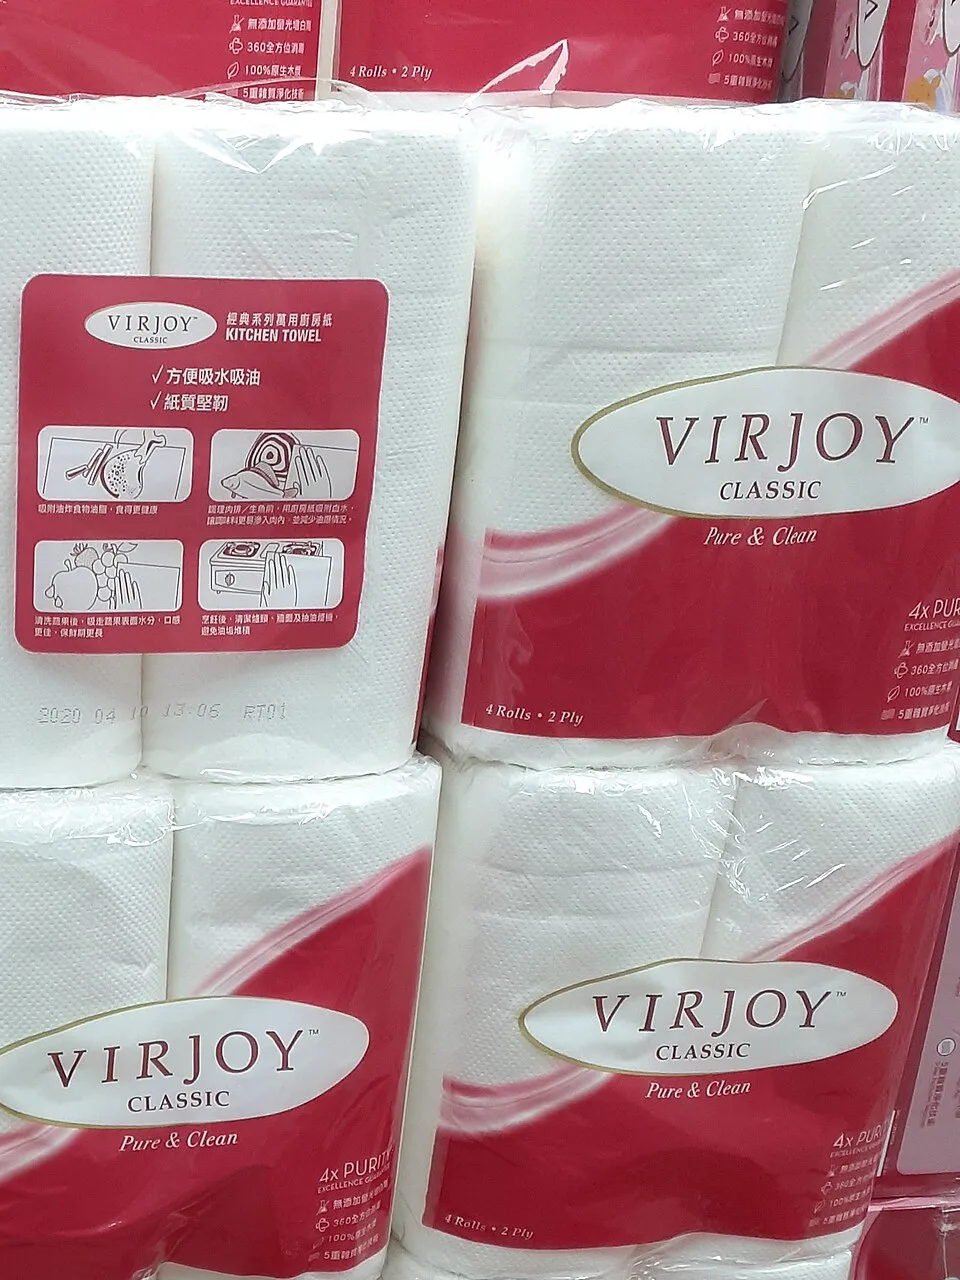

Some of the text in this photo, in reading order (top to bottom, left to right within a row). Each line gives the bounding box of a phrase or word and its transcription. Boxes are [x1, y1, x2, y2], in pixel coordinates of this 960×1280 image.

[349, 66, 433, 82] 4 Rolls 2 Ply
[108, 315, 191, 334] VIRJOY
[225, 328, 322, 343] KITCHEN TOWEL
[133, 336, 168, 344] CLASSIC
[166, 368, 261, 386] 方便吸水吸油
[657, 411, 915, 472] VIRJOY
[719, 479, 821, 502] CLASSIC
[704, 525, 817, 547] Pure & Clean
[37, 707, 81, 724] 2020
[93, 708, 116, 724] 04
[485, 704, 584, 728] 4 Rolls 2 Ply
[593, 990, 833, 1037] VIRJOY
[47, 1029, 304, 1089] VIRJOY
[656, 1043, 751, 1061] CLASSIC
[645, 1080, 751, 1099] Pure & Clean
[127, 1090, 230, 1113] CLASSIC
[119, 1129, 237, 1153] Pure & Clean
[319, 1146, 392, 1183] 4x PURITY
[445, 1213, 534, 1240] 4 Rolls 2 Ply
